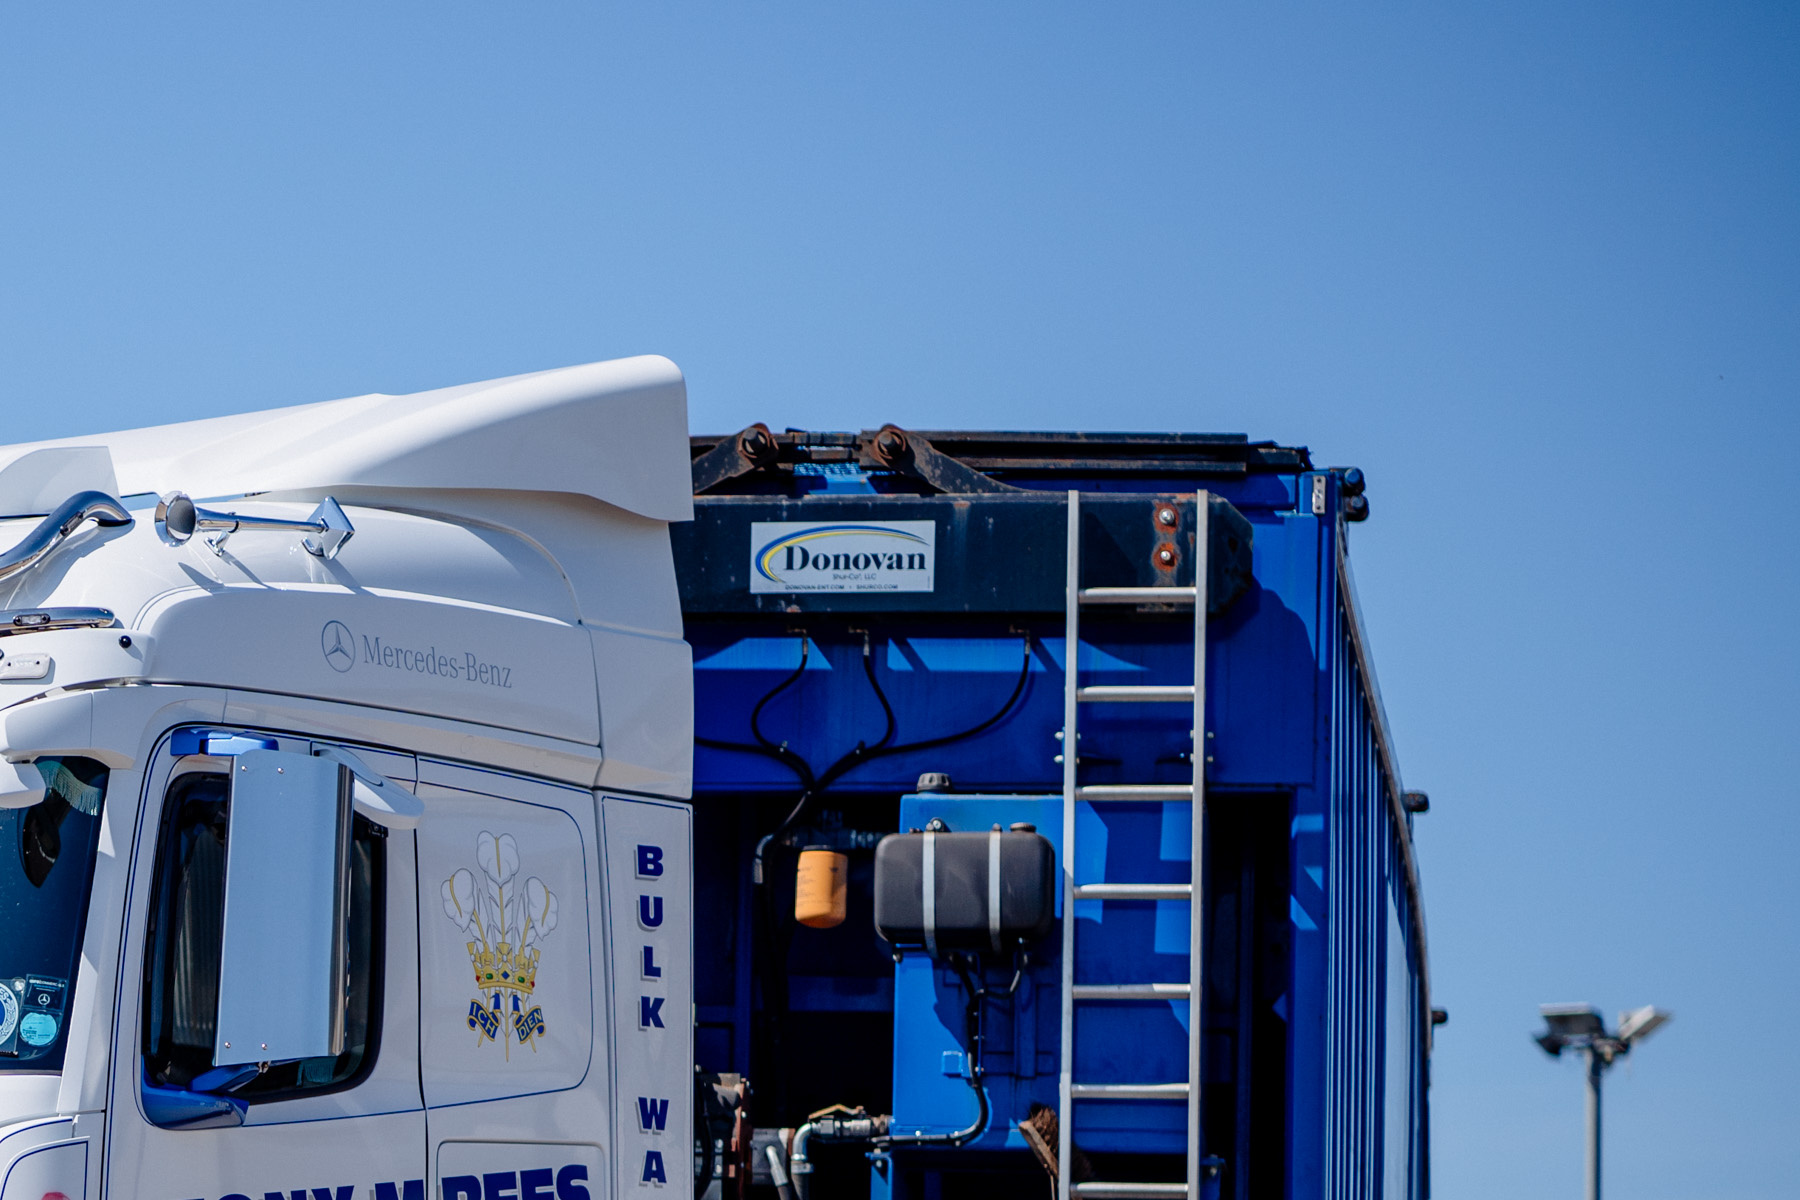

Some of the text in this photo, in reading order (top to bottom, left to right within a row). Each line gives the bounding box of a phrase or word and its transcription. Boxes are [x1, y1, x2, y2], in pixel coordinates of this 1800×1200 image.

[783, 544, 927, 571] Donovan
[361, 634, 512, 688] Mercedes-Benz
[637, 844, 665, 1029] BULK
[472, 1003, 543, 1040] ICH DIEN
